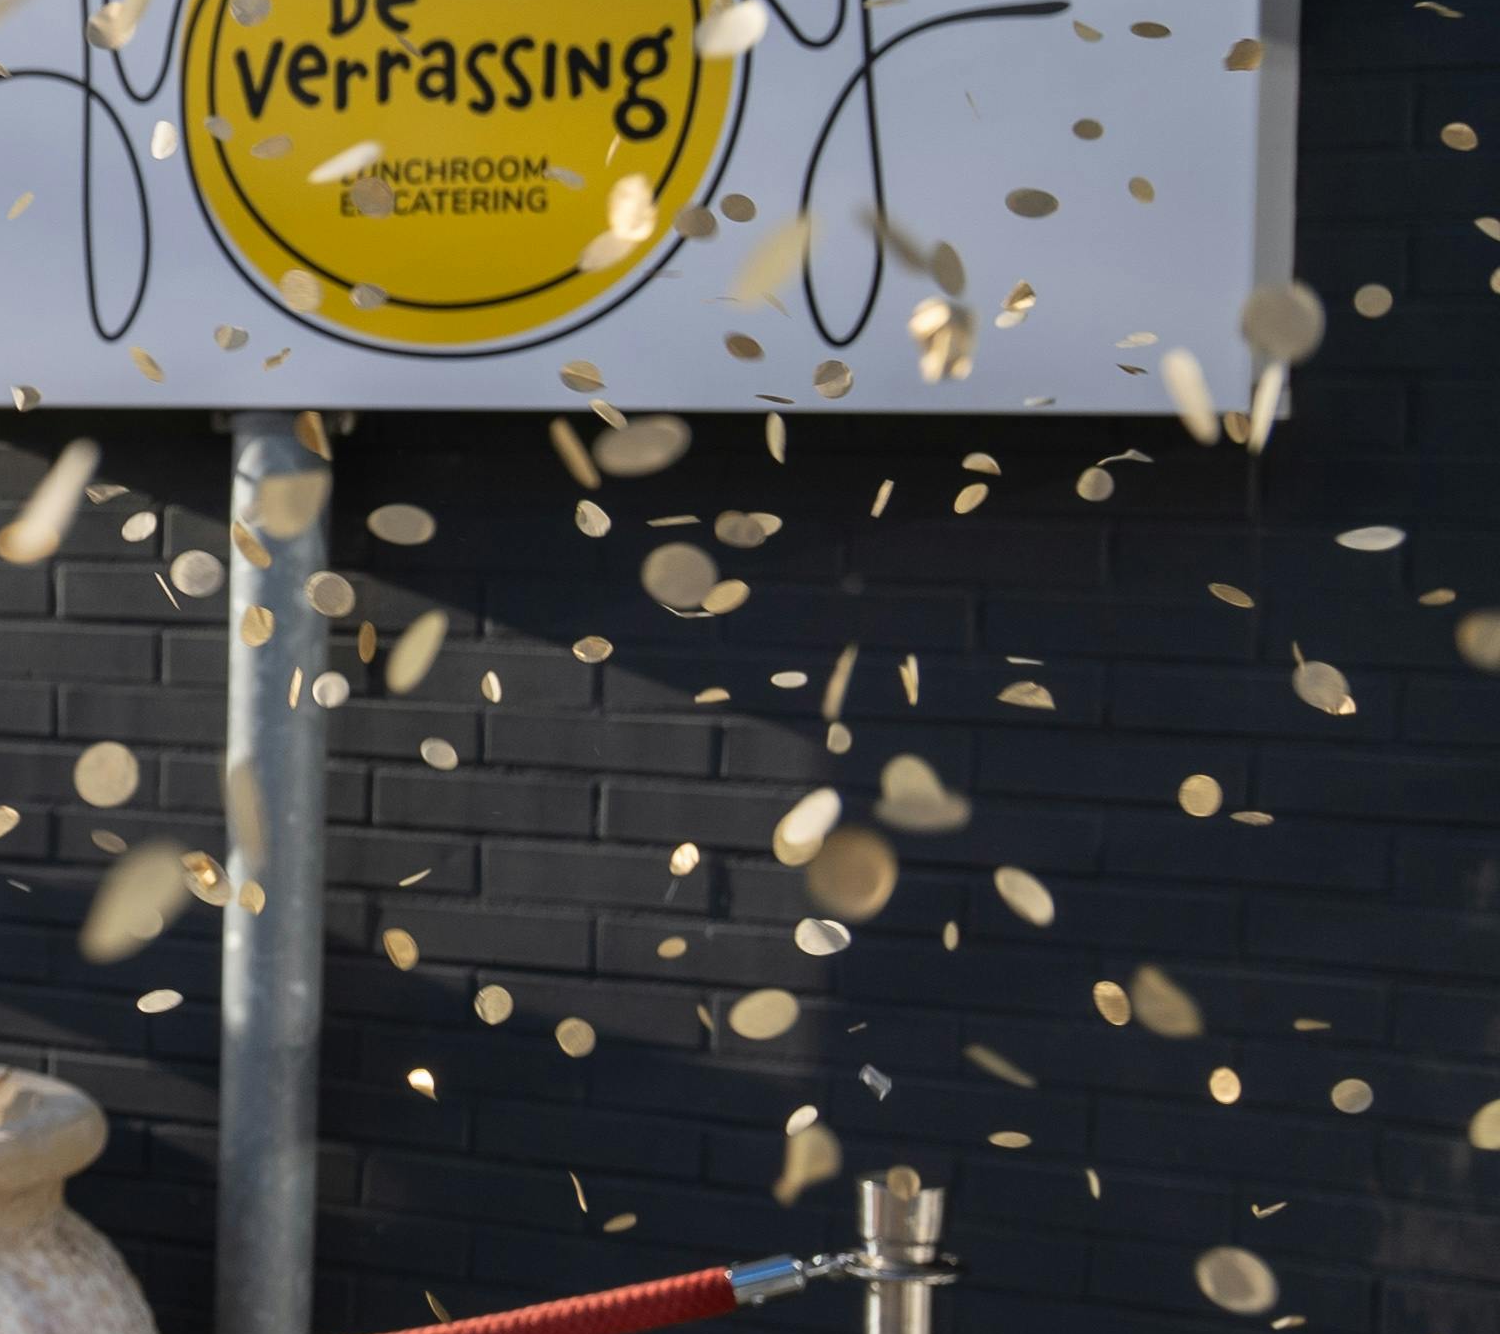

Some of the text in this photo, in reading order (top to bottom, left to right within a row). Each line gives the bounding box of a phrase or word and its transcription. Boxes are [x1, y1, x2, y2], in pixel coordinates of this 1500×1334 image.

[341, 156, 549, 186] NCHROOM
[340, 186, 548, 216] E CATERING
